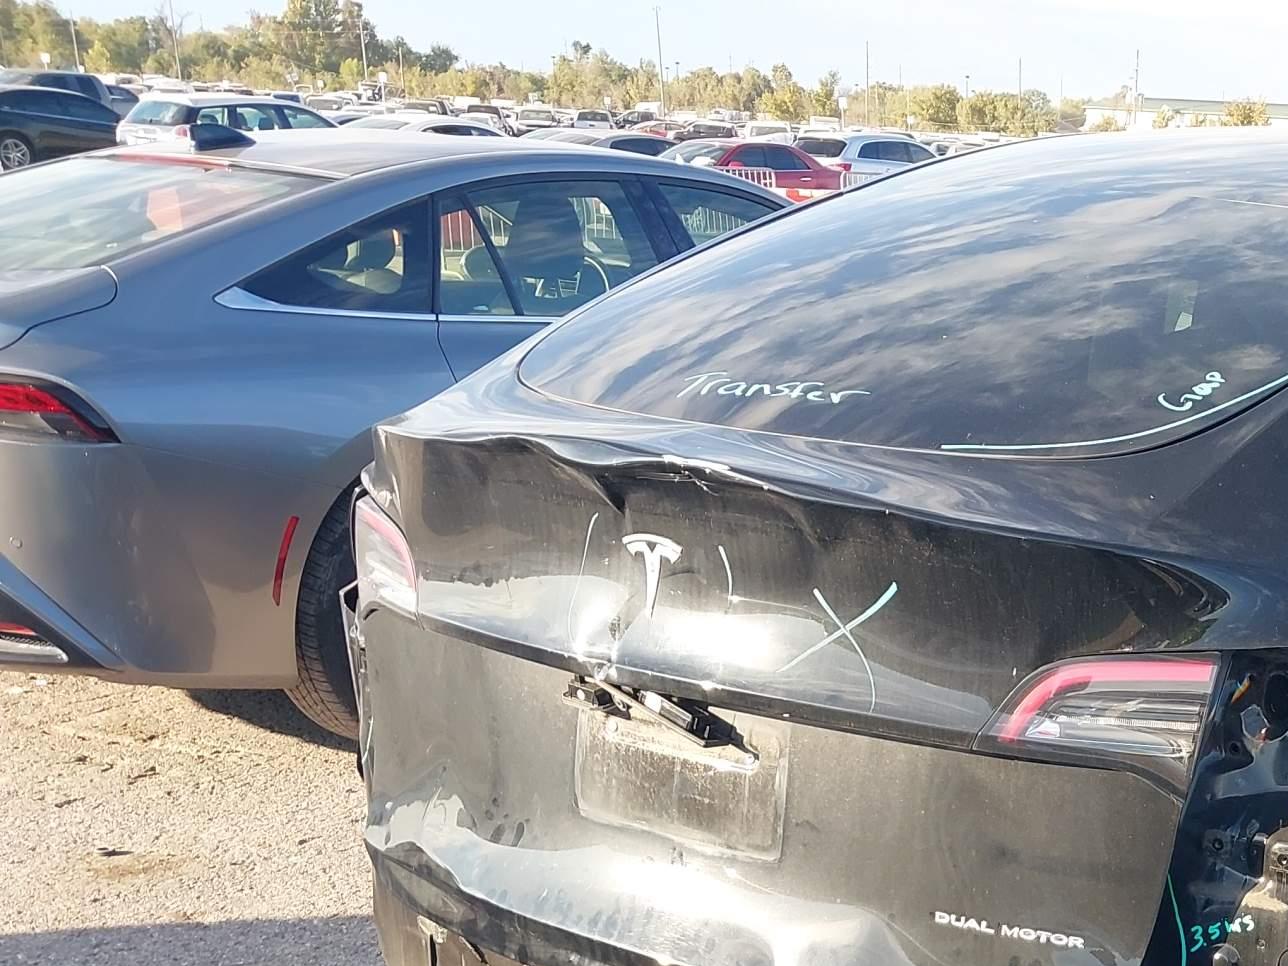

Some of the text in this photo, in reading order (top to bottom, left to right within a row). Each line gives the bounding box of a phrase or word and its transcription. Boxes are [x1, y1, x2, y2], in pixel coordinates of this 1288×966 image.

[676, 371, 871, 404] Transfer
[1157, 370, 1229, 412] Gap
[934, 911, 1085, 949] DUAL MOTOR
